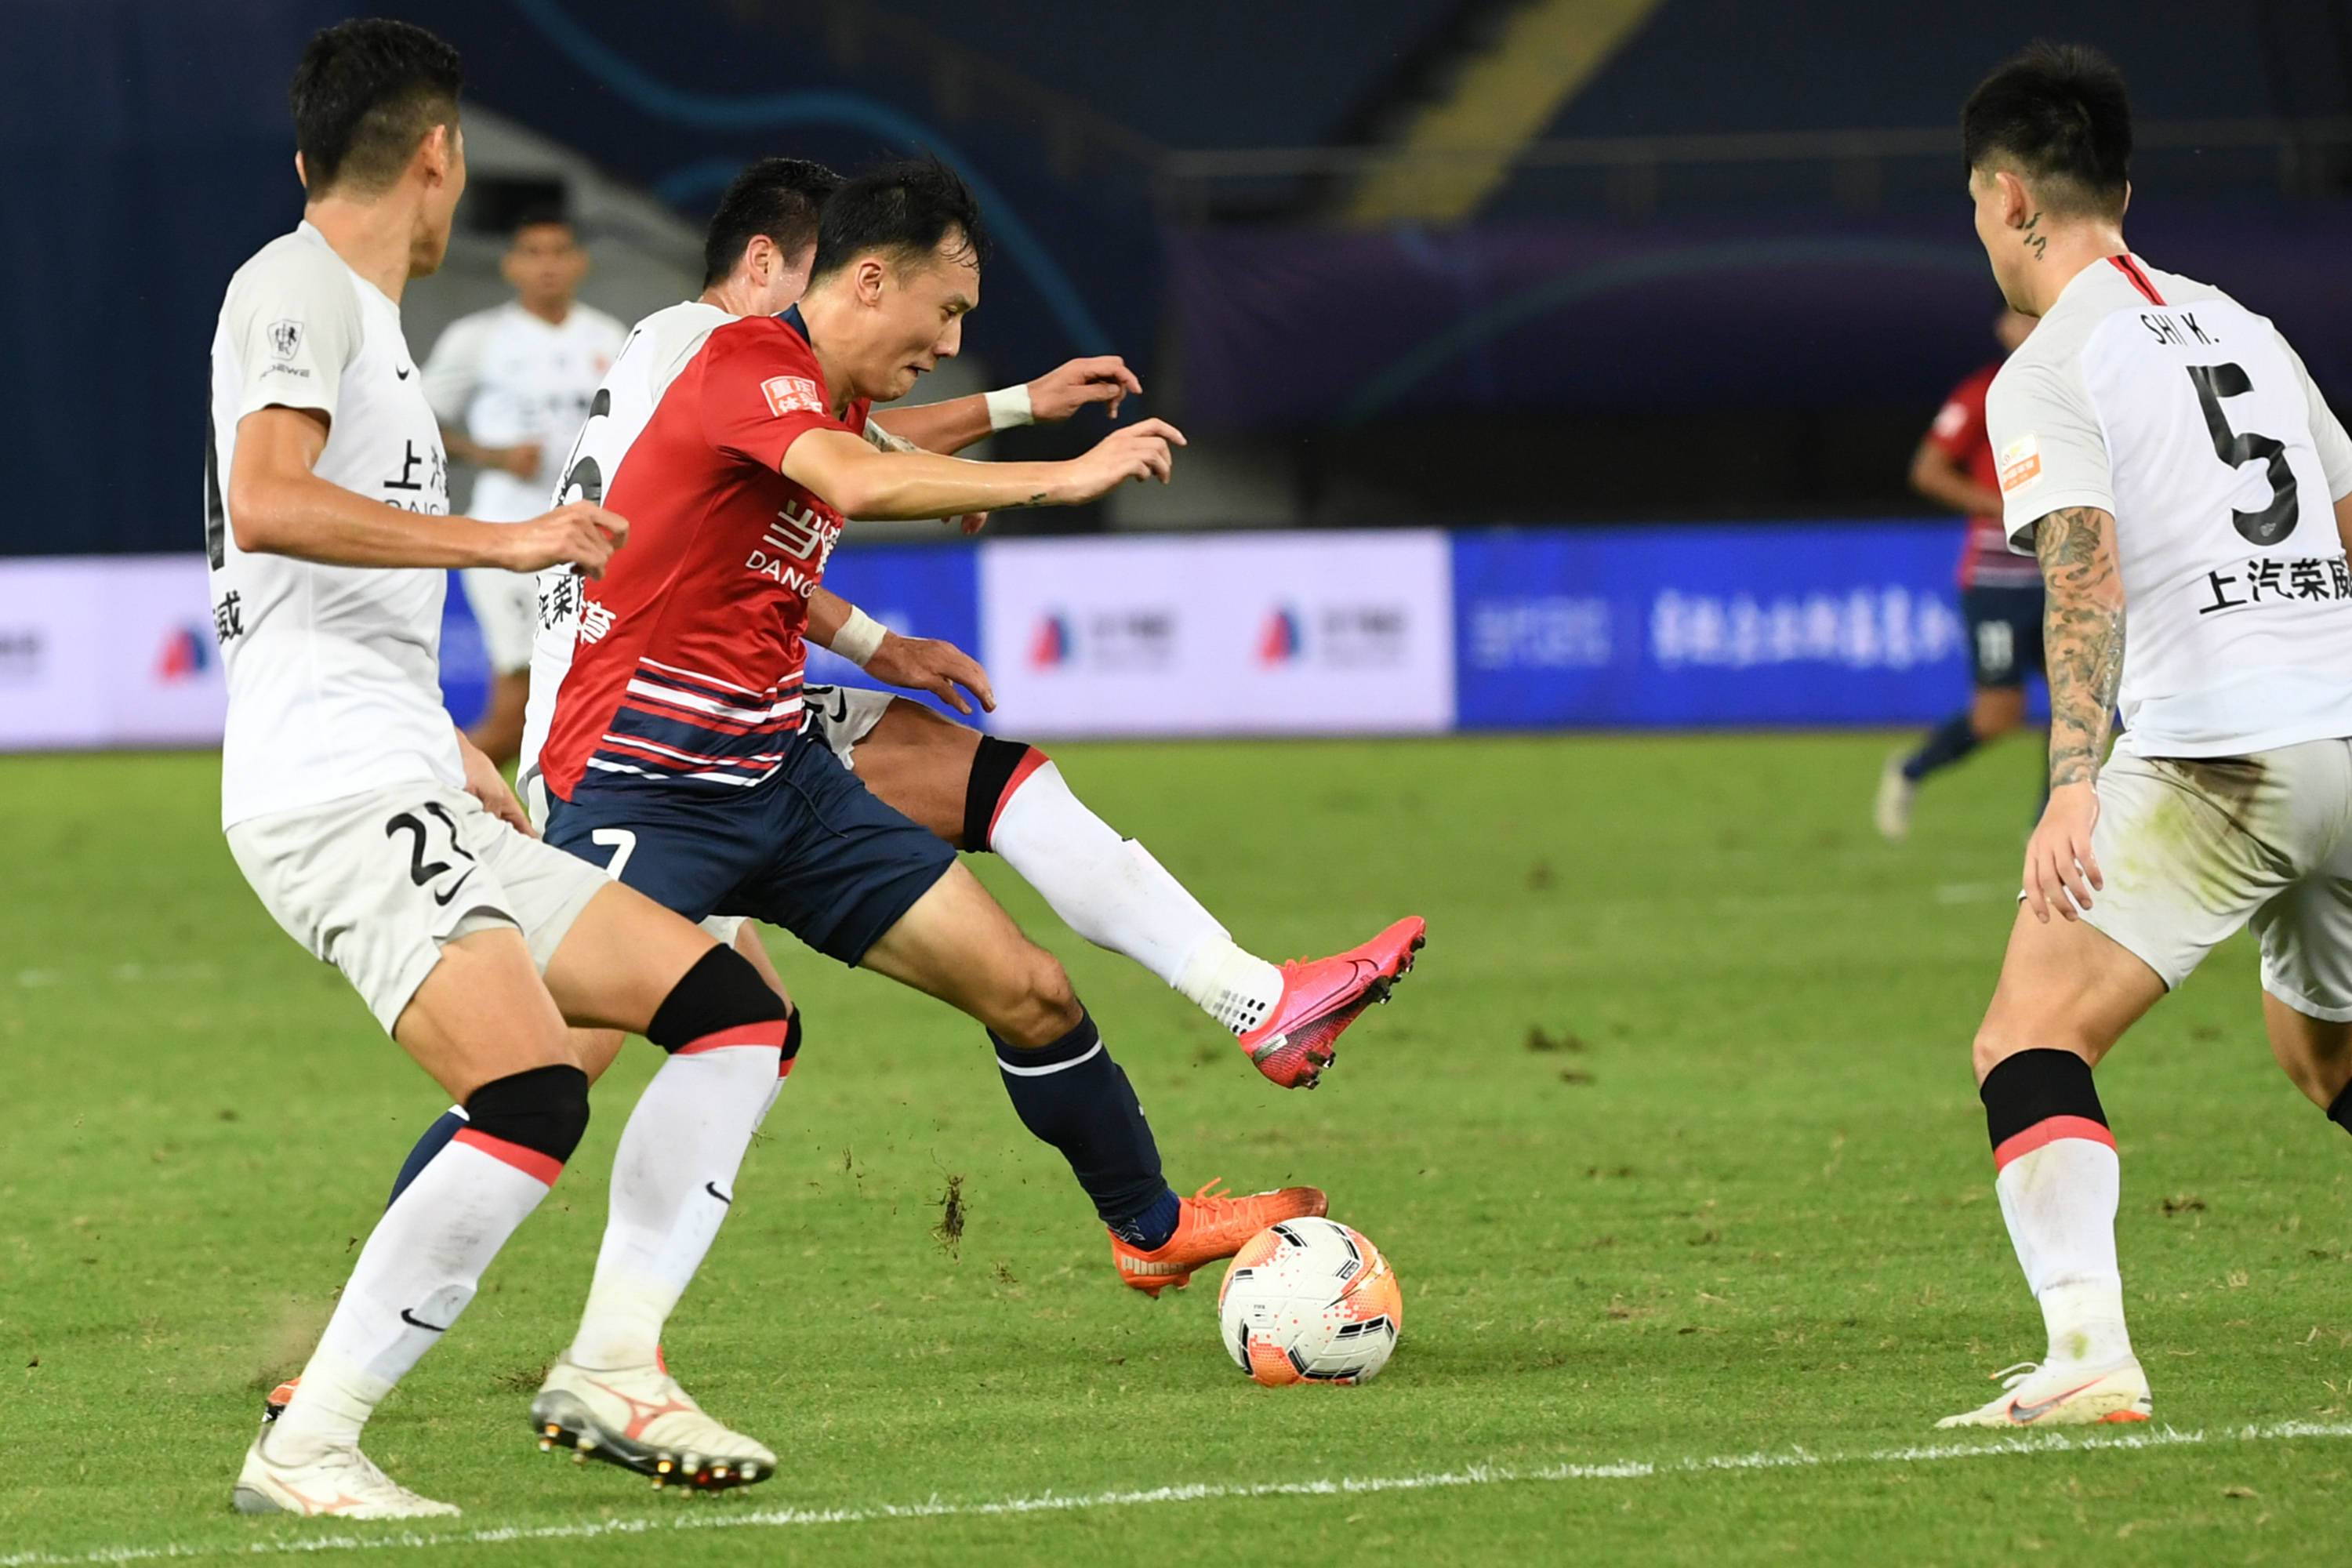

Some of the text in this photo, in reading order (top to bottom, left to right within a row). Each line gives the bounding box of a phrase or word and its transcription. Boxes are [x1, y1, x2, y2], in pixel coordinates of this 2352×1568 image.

[2140, 312, 2220, 347] SHI K.
[2186, 361, 2299, 546] 5
[386, 801, 475, 887] 21
[592, 828, 637, 880] 7
